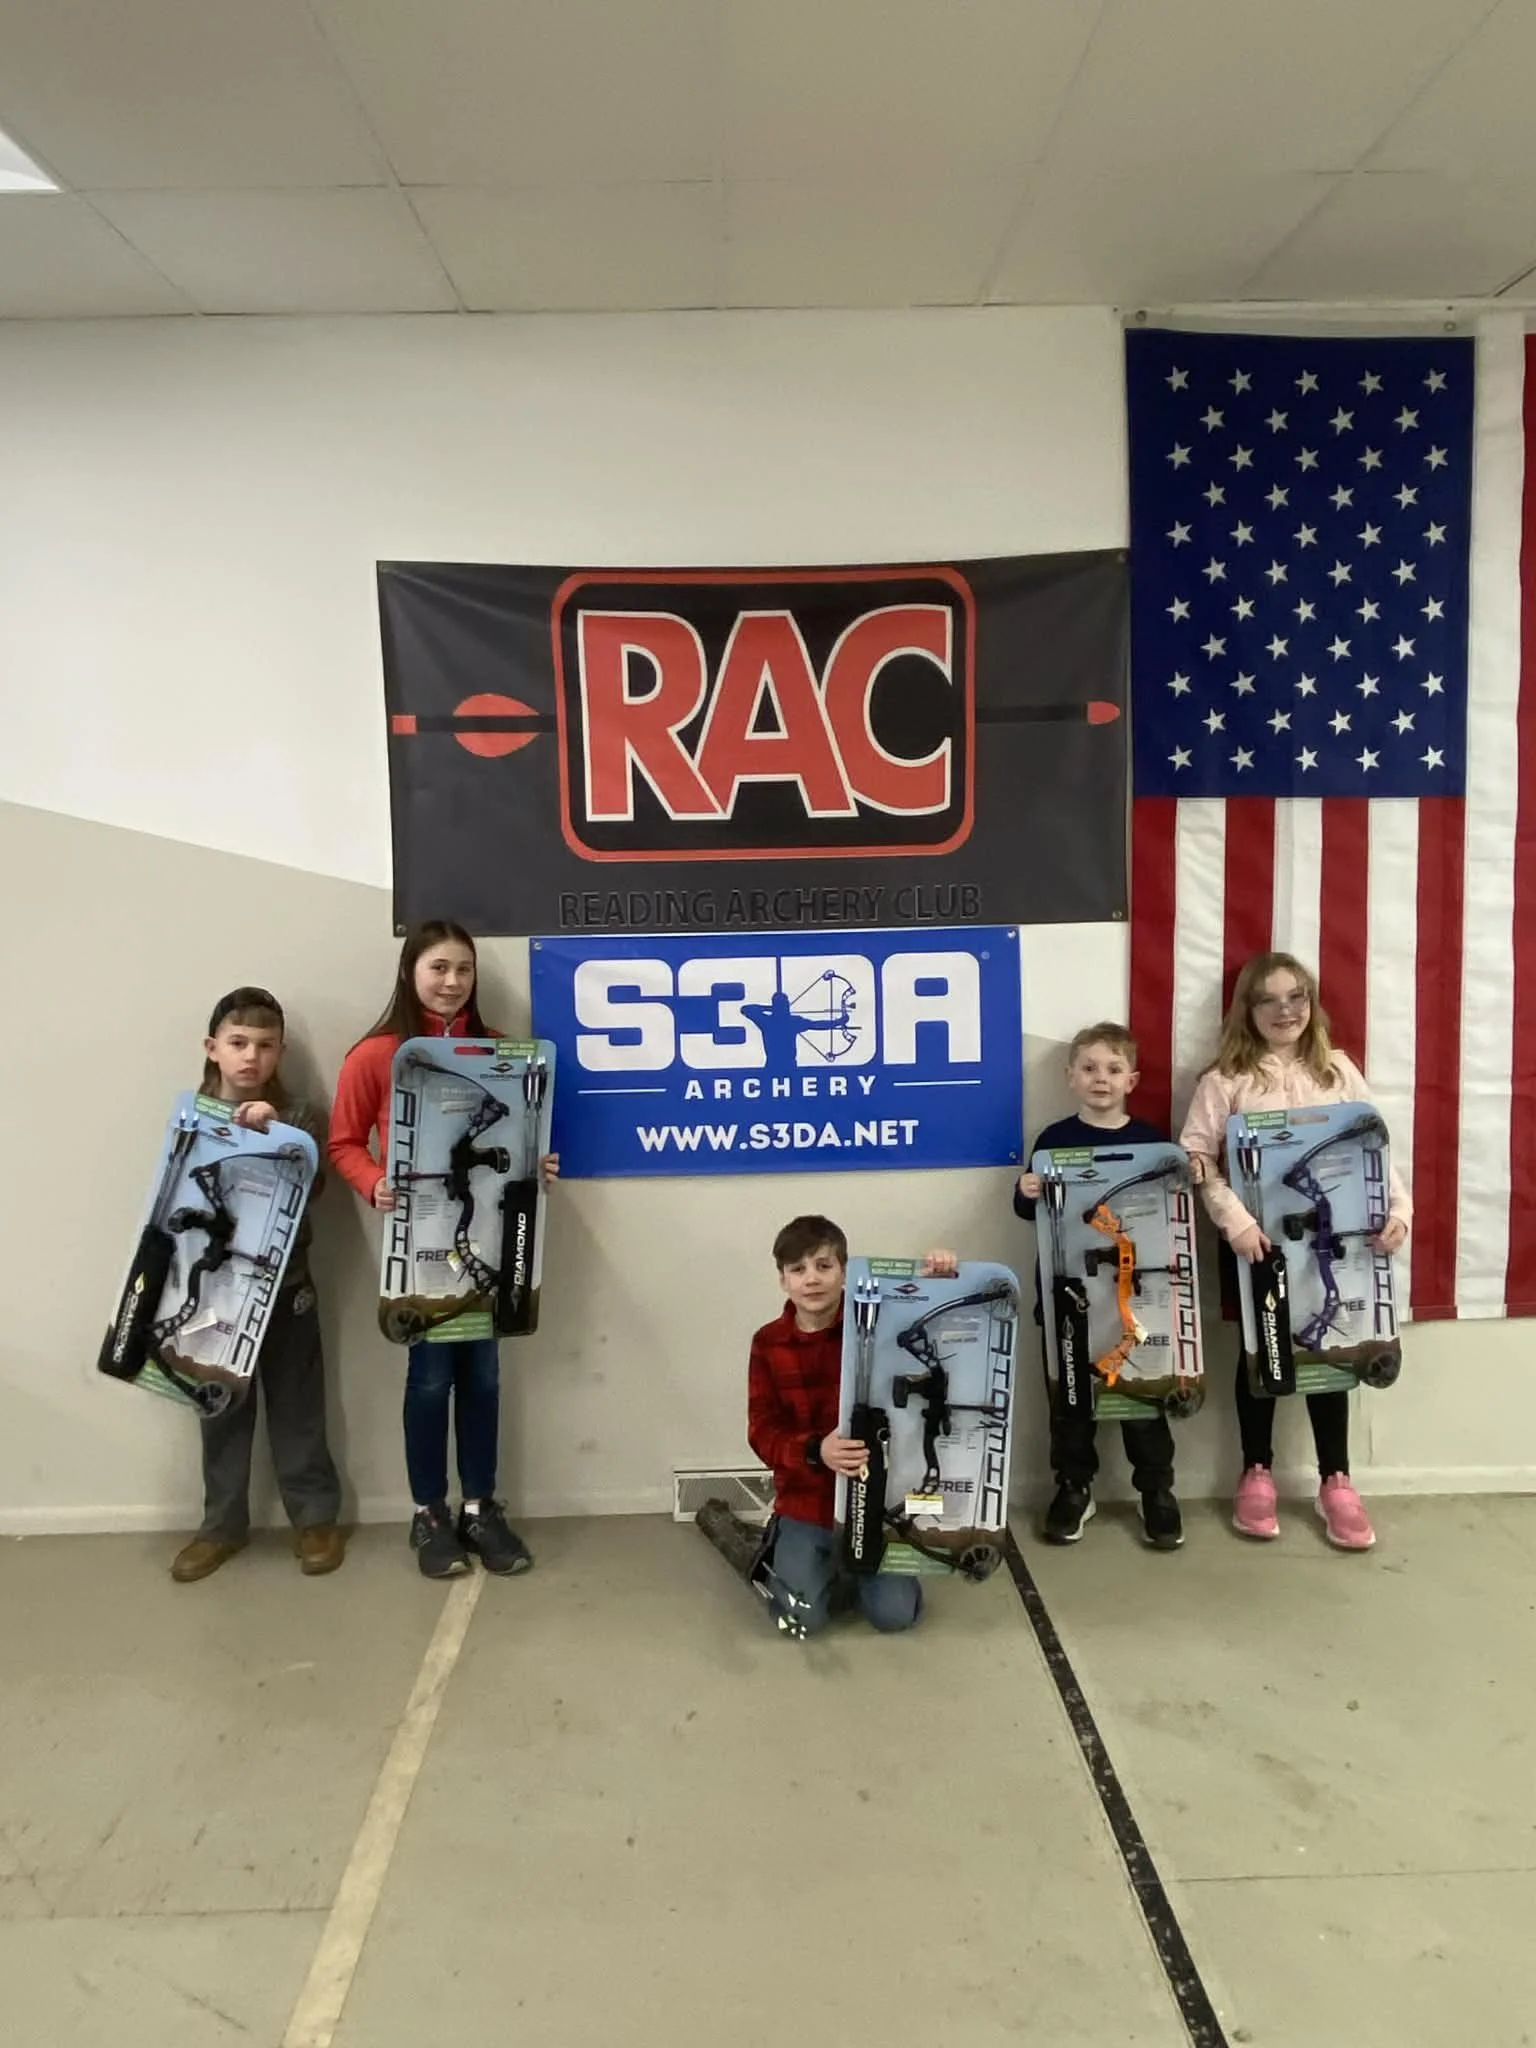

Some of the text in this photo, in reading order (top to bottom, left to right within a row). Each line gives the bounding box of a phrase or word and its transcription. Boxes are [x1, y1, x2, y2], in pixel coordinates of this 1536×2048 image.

[577, 604, 953, 822] RAC
[558, 883, 983, 928] READING ARCHERY CLUB
[574, 951, 982, 1072] S3DA
[684, 1075, 877, 1101] ARCHERY
[636, 1119, 920, 1153] WWW.S3DA.NET
[512, 1211, 527, 1286] DIAMOND
[1136, 1335, 1171, 1347] REE
[1267, 1311, 1282, 1381] DIAMOND
[854, 1483, 868, 1560] DIAMOND
